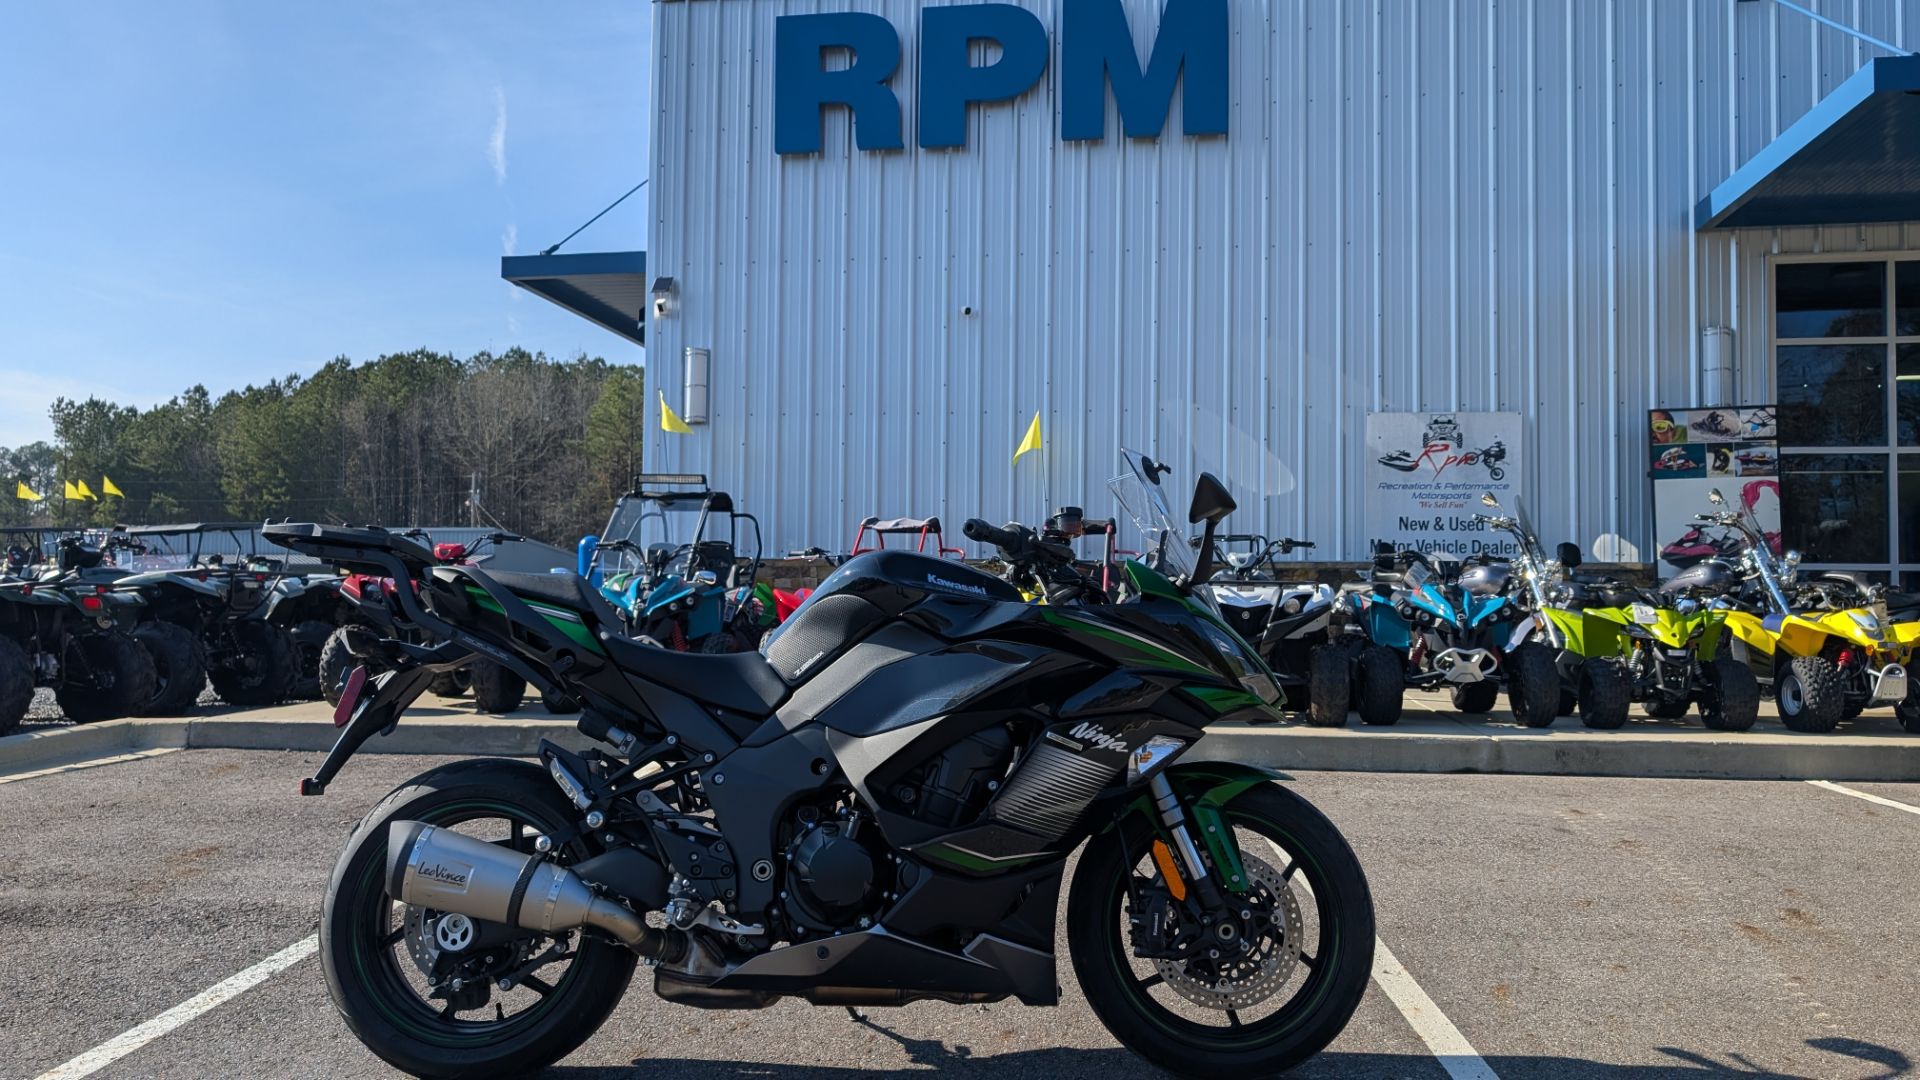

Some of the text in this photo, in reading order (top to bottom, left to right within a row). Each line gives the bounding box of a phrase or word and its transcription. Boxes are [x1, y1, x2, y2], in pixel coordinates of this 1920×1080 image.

[774, 0, 1229, 154] RPM
[1378, 482, 1510, 490] Recreation & Performance
[1411, 492, 1472, 500] Motorsports
[1399, 516, 1484, 531] New & Used
[1370, 539, 1518, 554] Mtor Vehicle Dealer
[927, 573, 987, 595] Kawasaki
[1069, 722, 1128, 752] Ninja
[418, 861, 466, 883] LeoVince
